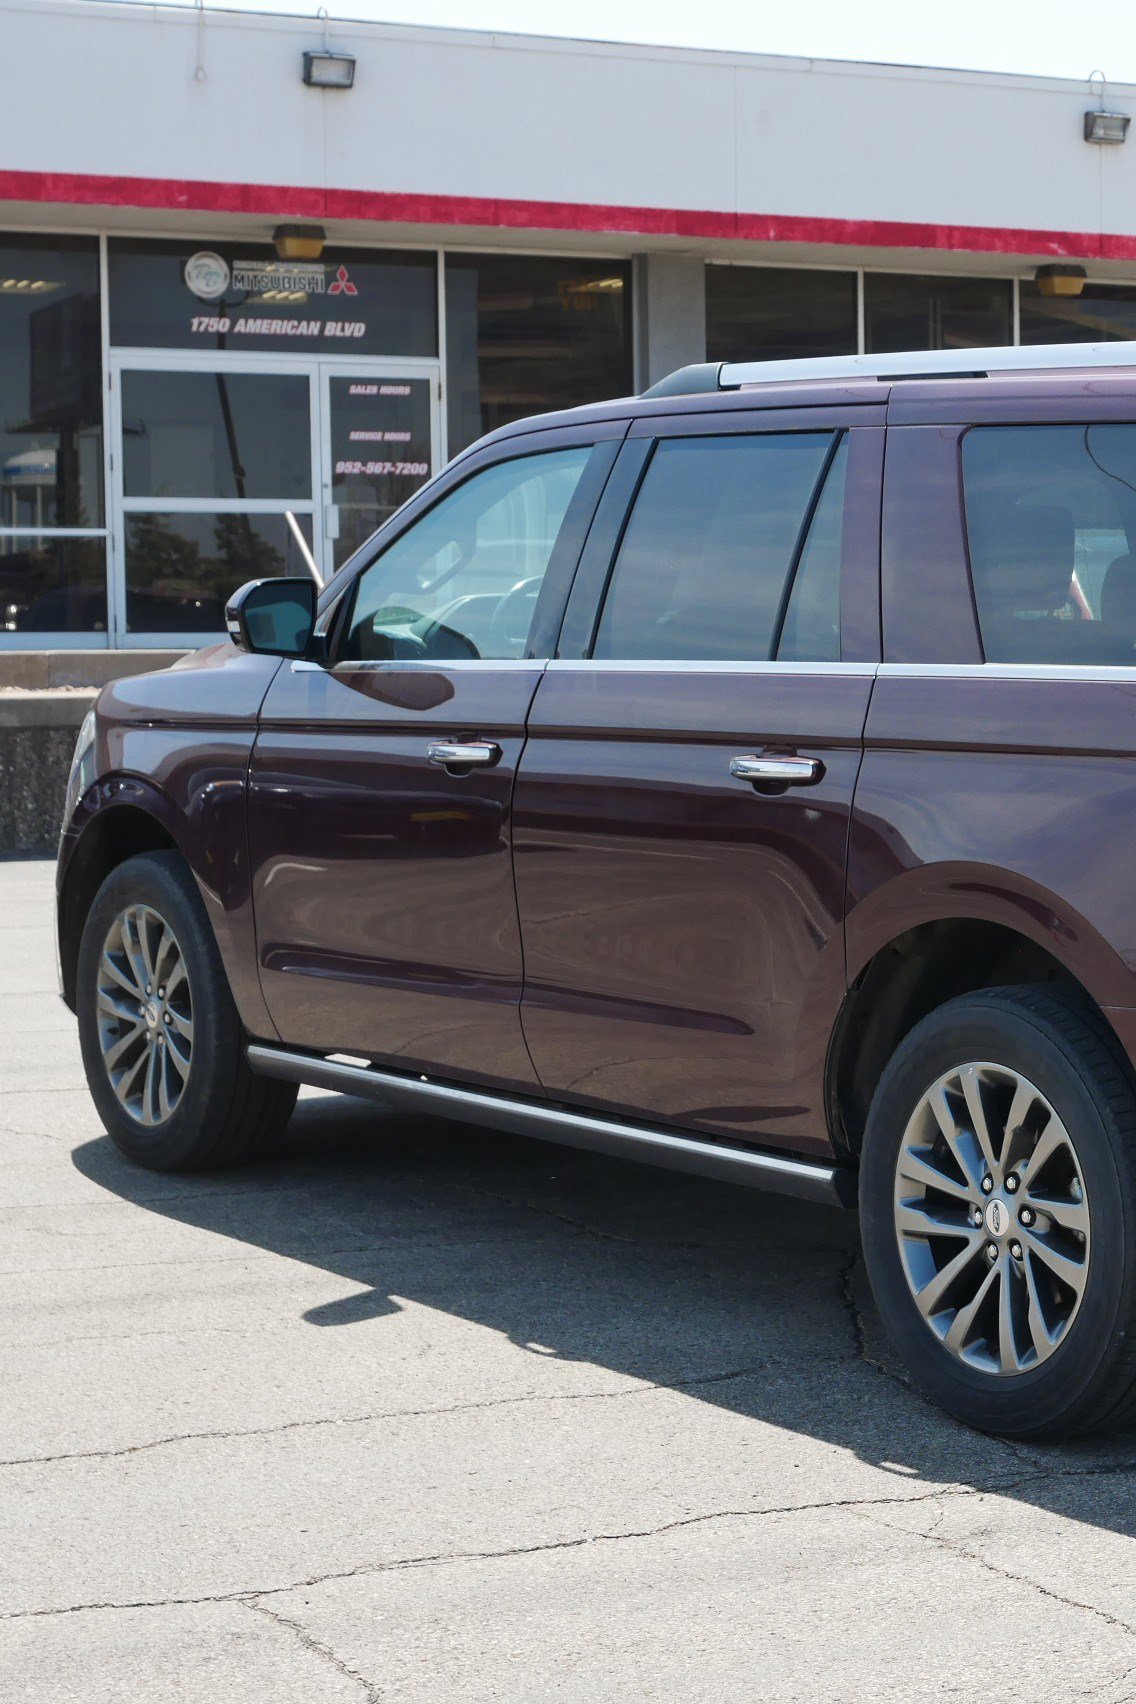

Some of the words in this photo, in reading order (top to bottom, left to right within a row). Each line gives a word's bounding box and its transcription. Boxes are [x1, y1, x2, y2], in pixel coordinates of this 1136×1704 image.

[232, 273, 325, 293] MITSUBISHI
[191, 317, 231, 334] 1750
[233, 318, 321, 336] AMERICAN
[323, 321, 366, 338] BLVD
[349, 384, 379, 395] SALES
[380, 385, 411, 396] HOURS
[349, 431, 383, 441] SERVICE
[383, 432, 411, 442] HOURS
[335, 461, 428, 475] 952-567-7200
